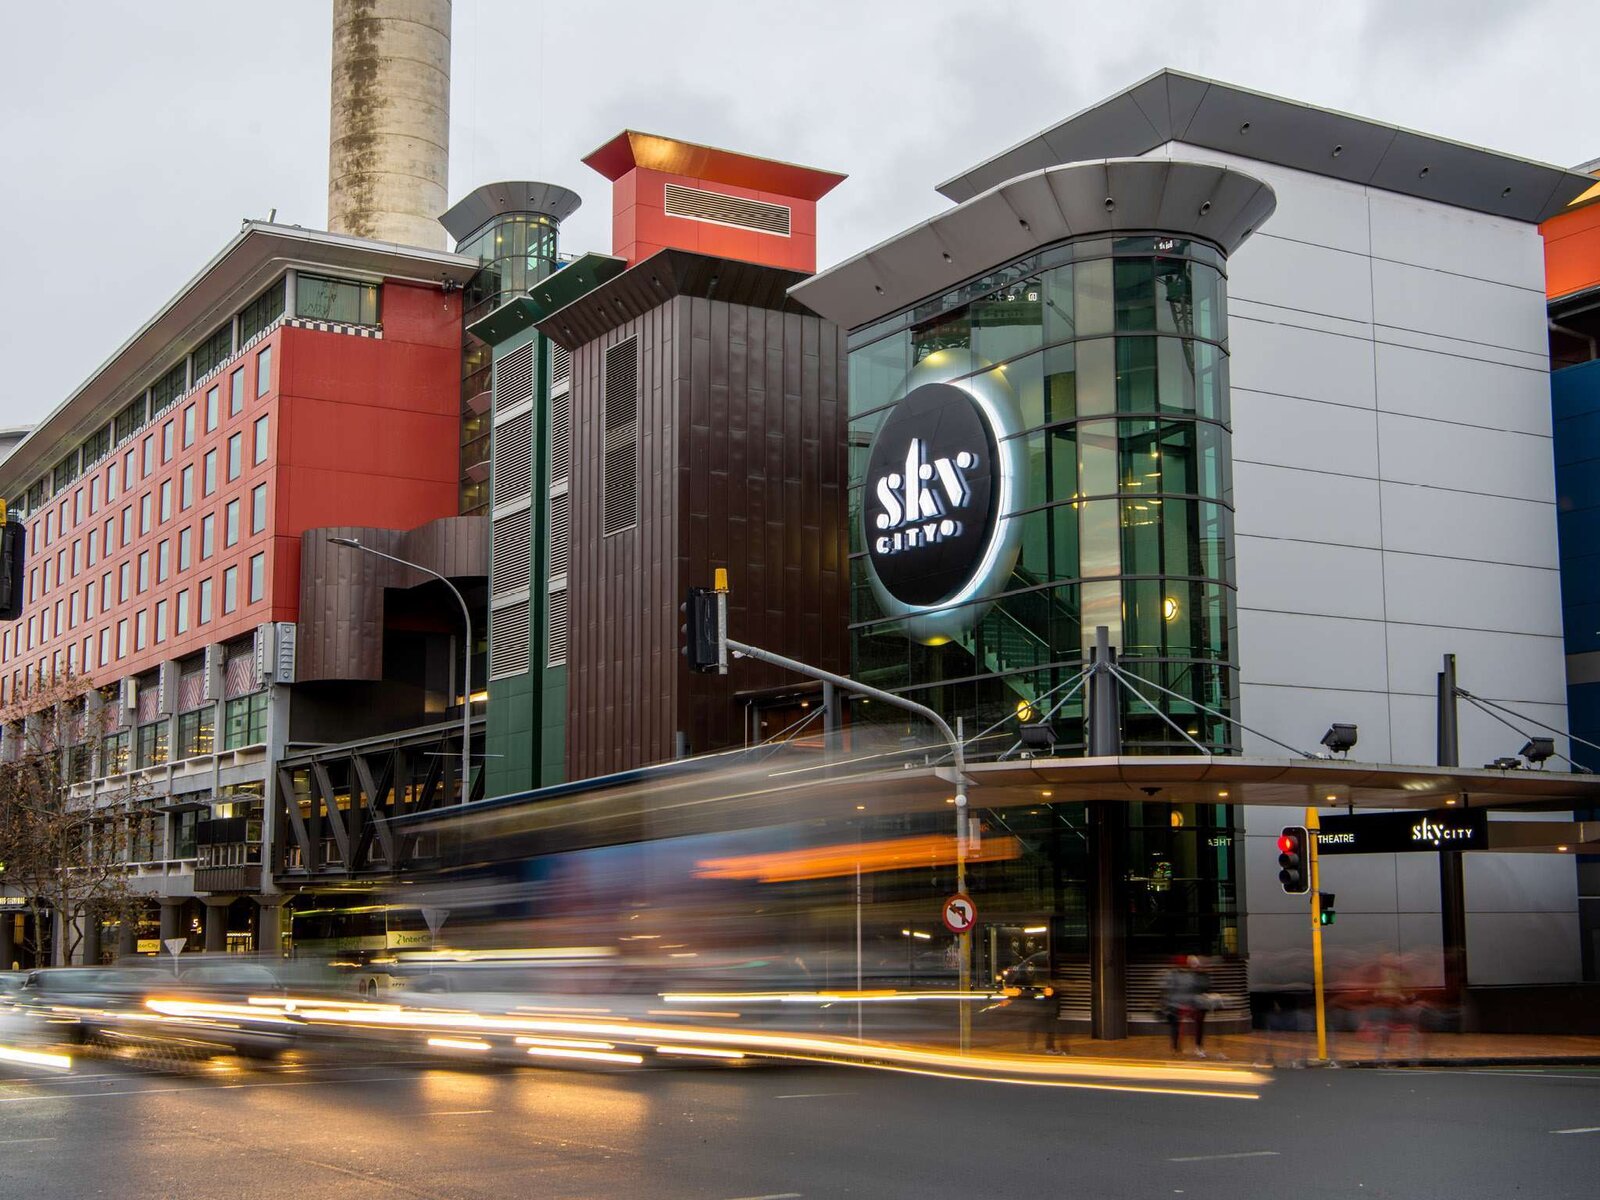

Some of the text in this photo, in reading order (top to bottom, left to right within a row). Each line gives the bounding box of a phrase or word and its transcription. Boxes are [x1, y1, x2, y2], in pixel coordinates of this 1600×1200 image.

[877, 438, 974, 536] sky
[877, 523, 938, 554] CITY
[1317, 834, 1355, 844] THEATRE
